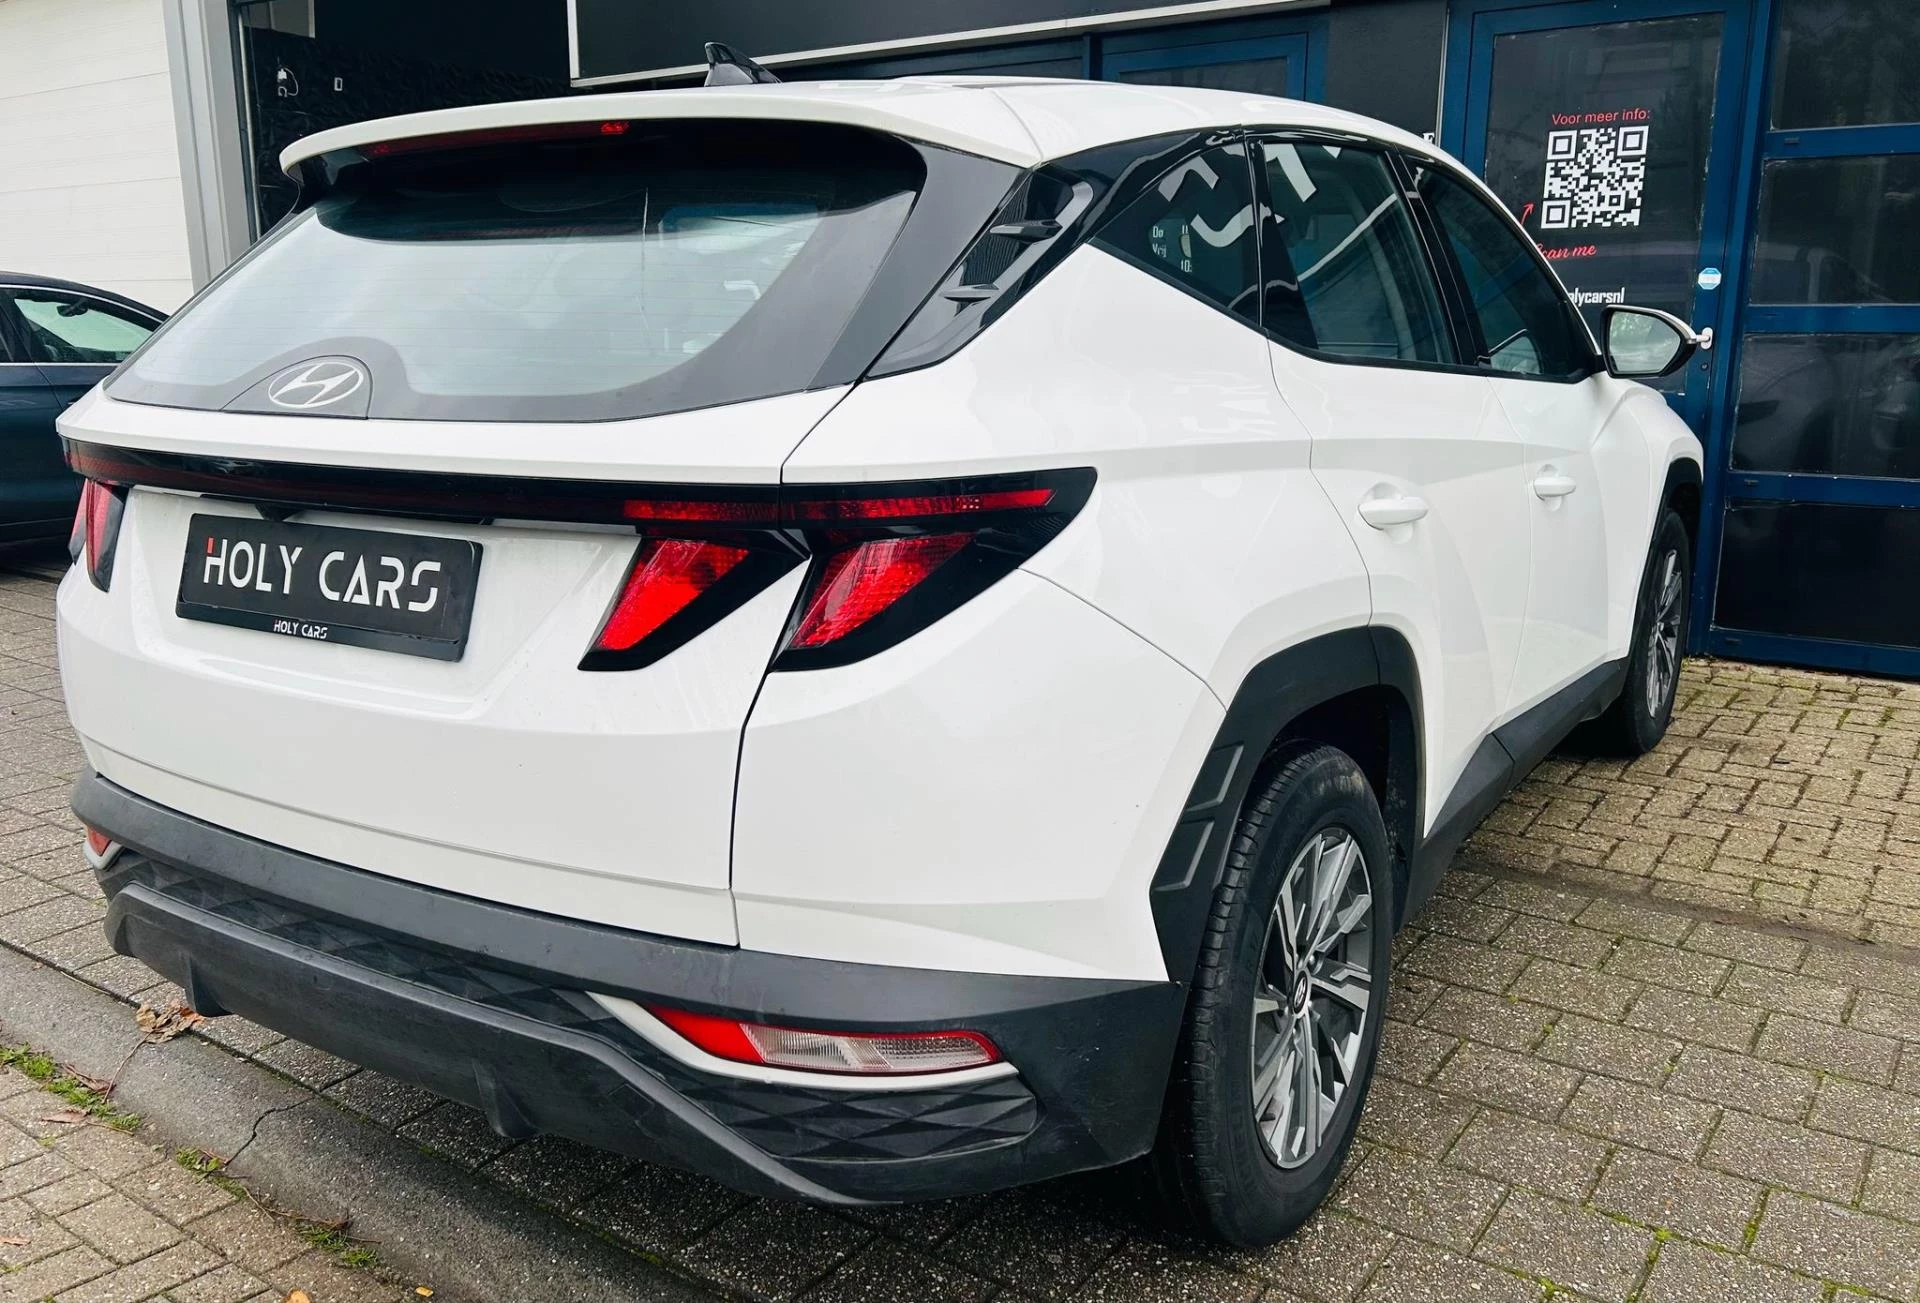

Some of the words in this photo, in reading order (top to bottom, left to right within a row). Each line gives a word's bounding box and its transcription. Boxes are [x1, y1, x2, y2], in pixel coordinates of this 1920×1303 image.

[1552, 112, 1582, 126] Voor
[1585, 111, 1619, 123] meer
[1622, 108, 1651, 122] info:
[1572, 244, 1598, 257] me
[1568, 286, 1625, 307] olycarsnl
[203, 537, 303, 595] HOLY
[318, 551, 442, 613] CARS
[273, 619, 300, 635] HOLY
[301, 624, 329, 640] CARS
